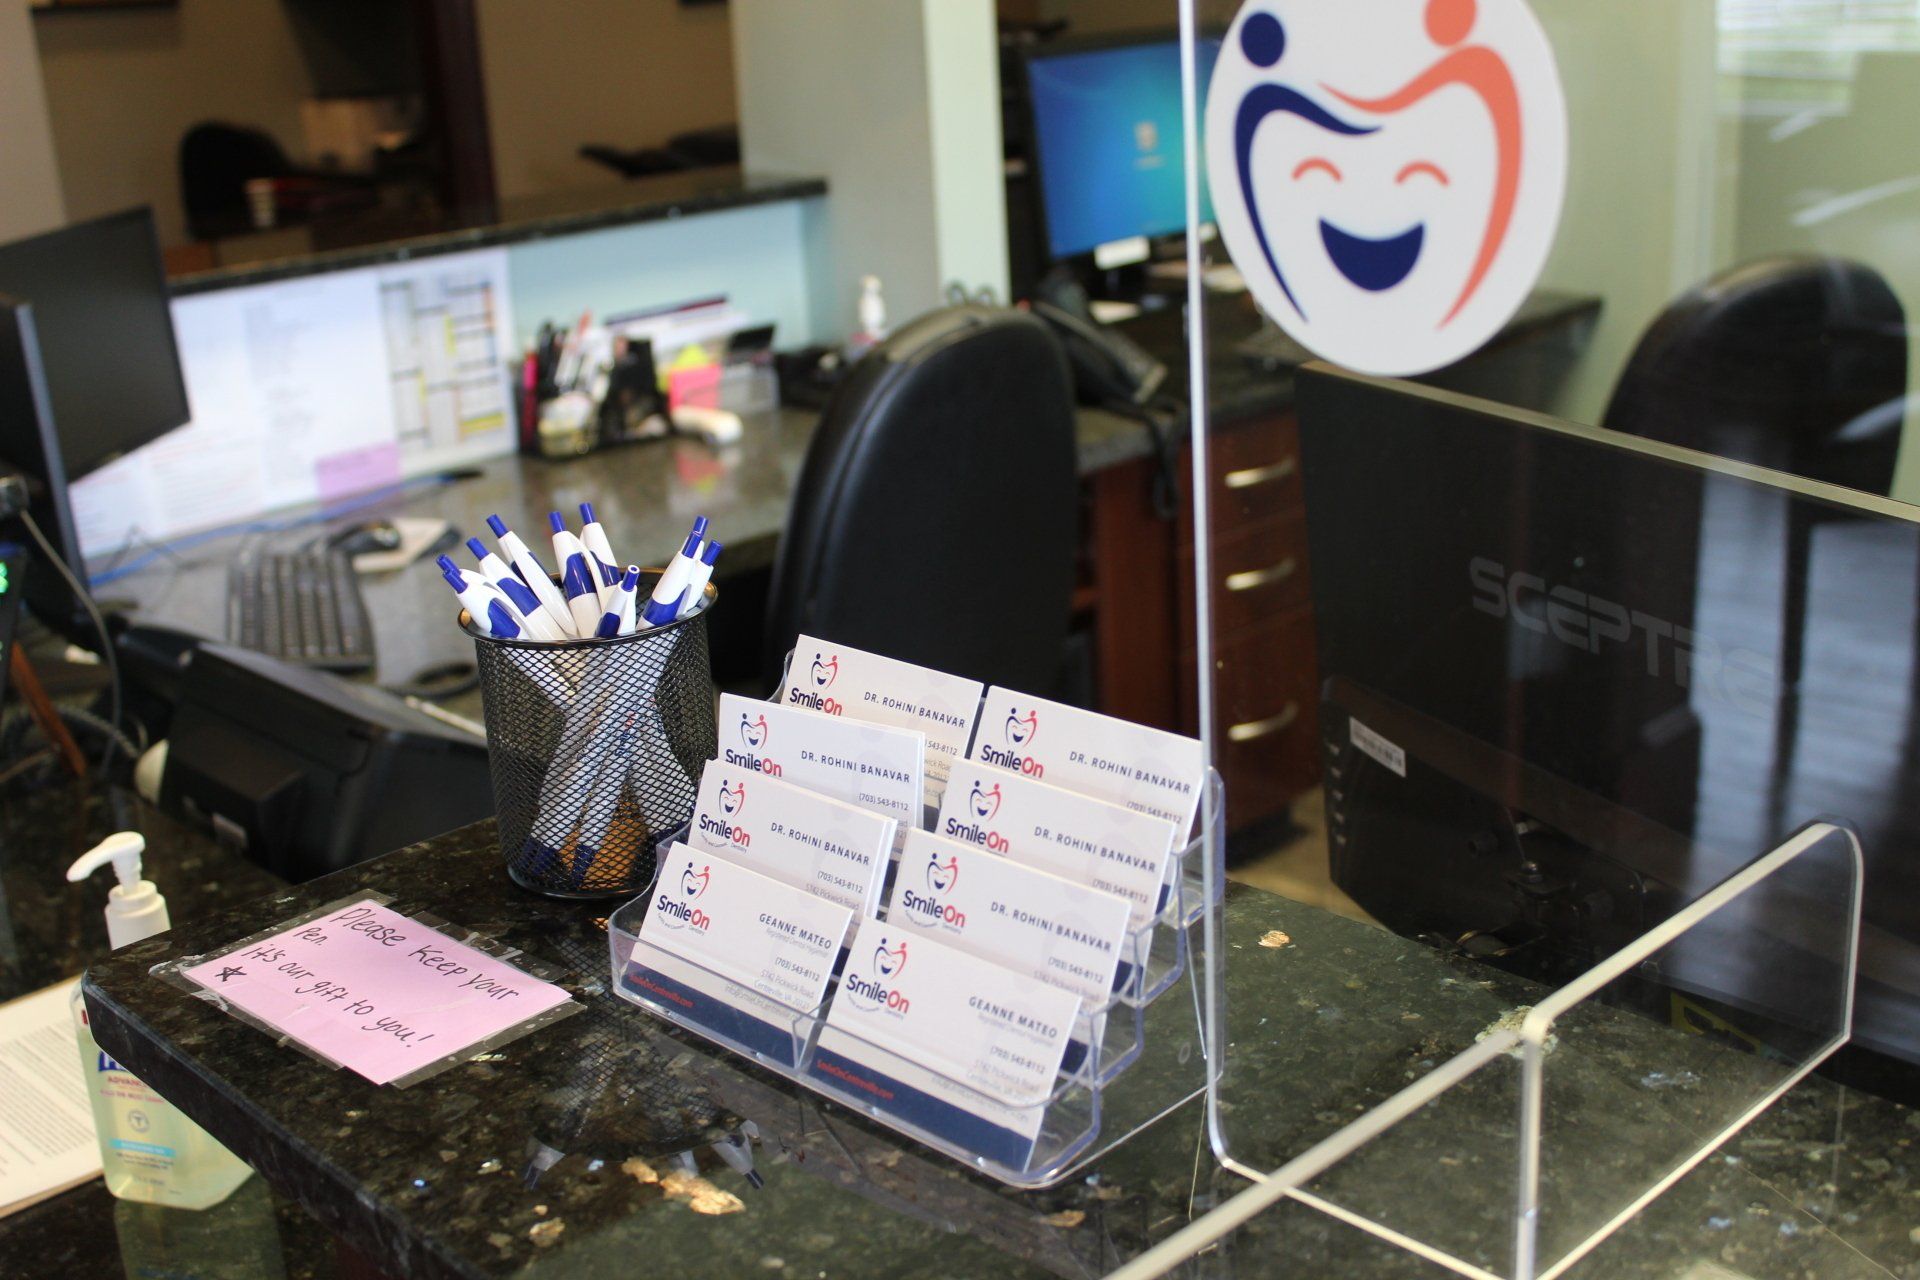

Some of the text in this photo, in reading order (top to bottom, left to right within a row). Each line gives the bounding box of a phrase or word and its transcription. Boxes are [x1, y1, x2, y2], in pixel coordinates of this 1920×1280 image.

[789, 686, 842, 716] SmileOn
[864, 691, 965, 729] DR. ROHINI BANAVAR
[725, 748, 782, 778] SmileOn
[927, 740, 958, 755] 543-8112
[981, 744, 1044, 779] SmileOn
[801, 750, 817, 763] DR.
[821, 755, 857, 771] ROHINI
[860, 763, 910, 783] BANAVAR
[1069, 751, 1191, 794] DR. ROHINI BANAVAR
[859, 792, 909, 811] (703) 543-8112
[699, 813, 750, 847] SmileOn
[771, 822, 870, 865] DR. ROHINI BANAVAR
[946, 817, 1009, 854] SmileOn
[1034, 826, 1157, 873] DR. ROHINI BANAVAR
[817, 869, 864, 894] (703) 543-8112
[329, 907, 407, 947] Please
[656, 894, 711, 931] SmileOn
[902, 889, 966, 928] SmileOn
[991, 901, 1112, 953] DR. ROHINI BANAVAR
[759, 912, 832, 949] GEANNE MATEO
[775, 956, 820, 982] (703) 543-8112
[241, 943, 435, 1048] it's our gift to you!
[846, 973, 910, 1014] SmileOn
[968, 996, 1015, 1022] GEANNE
[1017, 1015, 1058, 1039] MATEO
